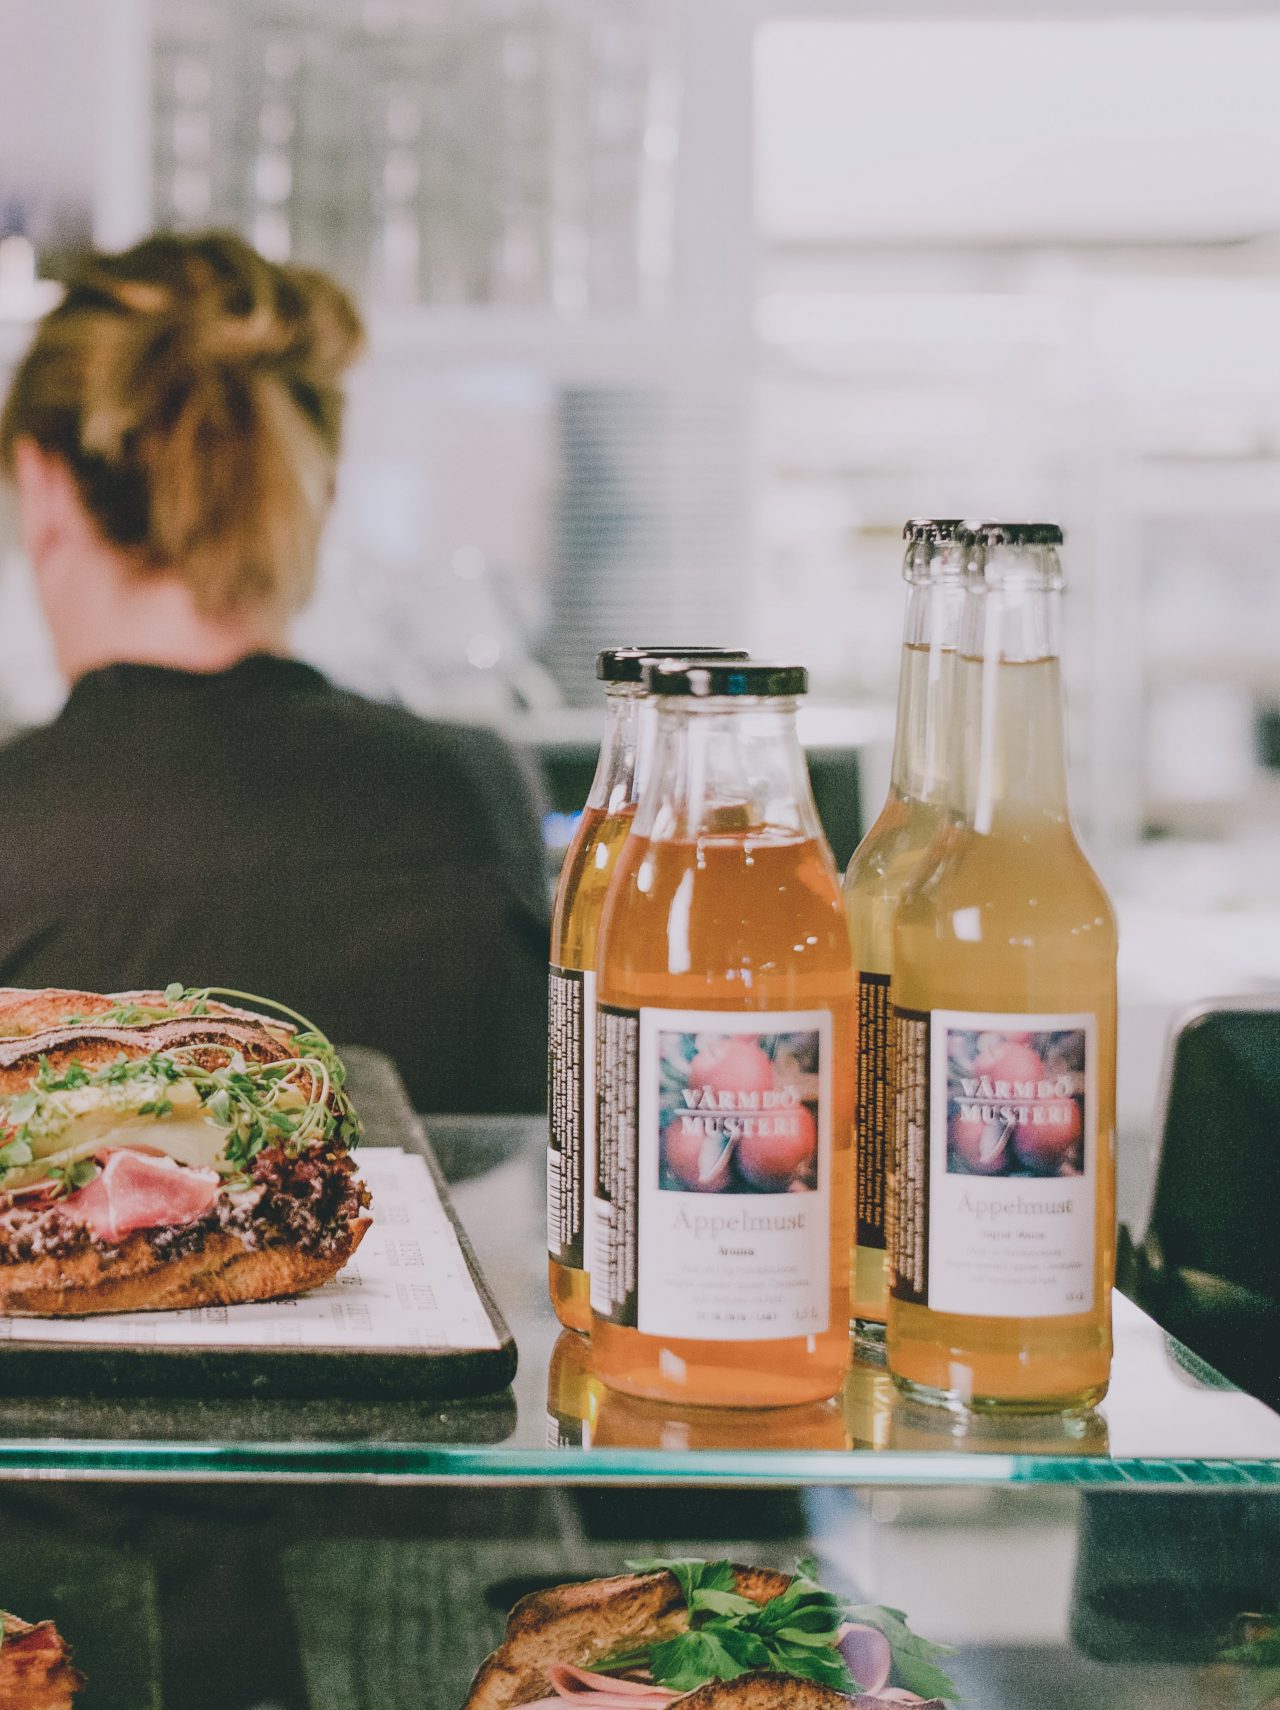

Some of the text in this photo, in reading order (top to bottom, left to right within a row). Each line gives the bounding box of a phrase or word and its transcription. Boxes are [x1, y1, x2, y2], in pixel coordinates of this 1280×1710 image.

[681, 1116, 799, 1137] MUSTERI
[960, 1104, 1072, 1126] MUSTERI
[957, 1188, 1073, 1221] Äppelmust
[672, 1202, 807, 1239] Äppelmust
